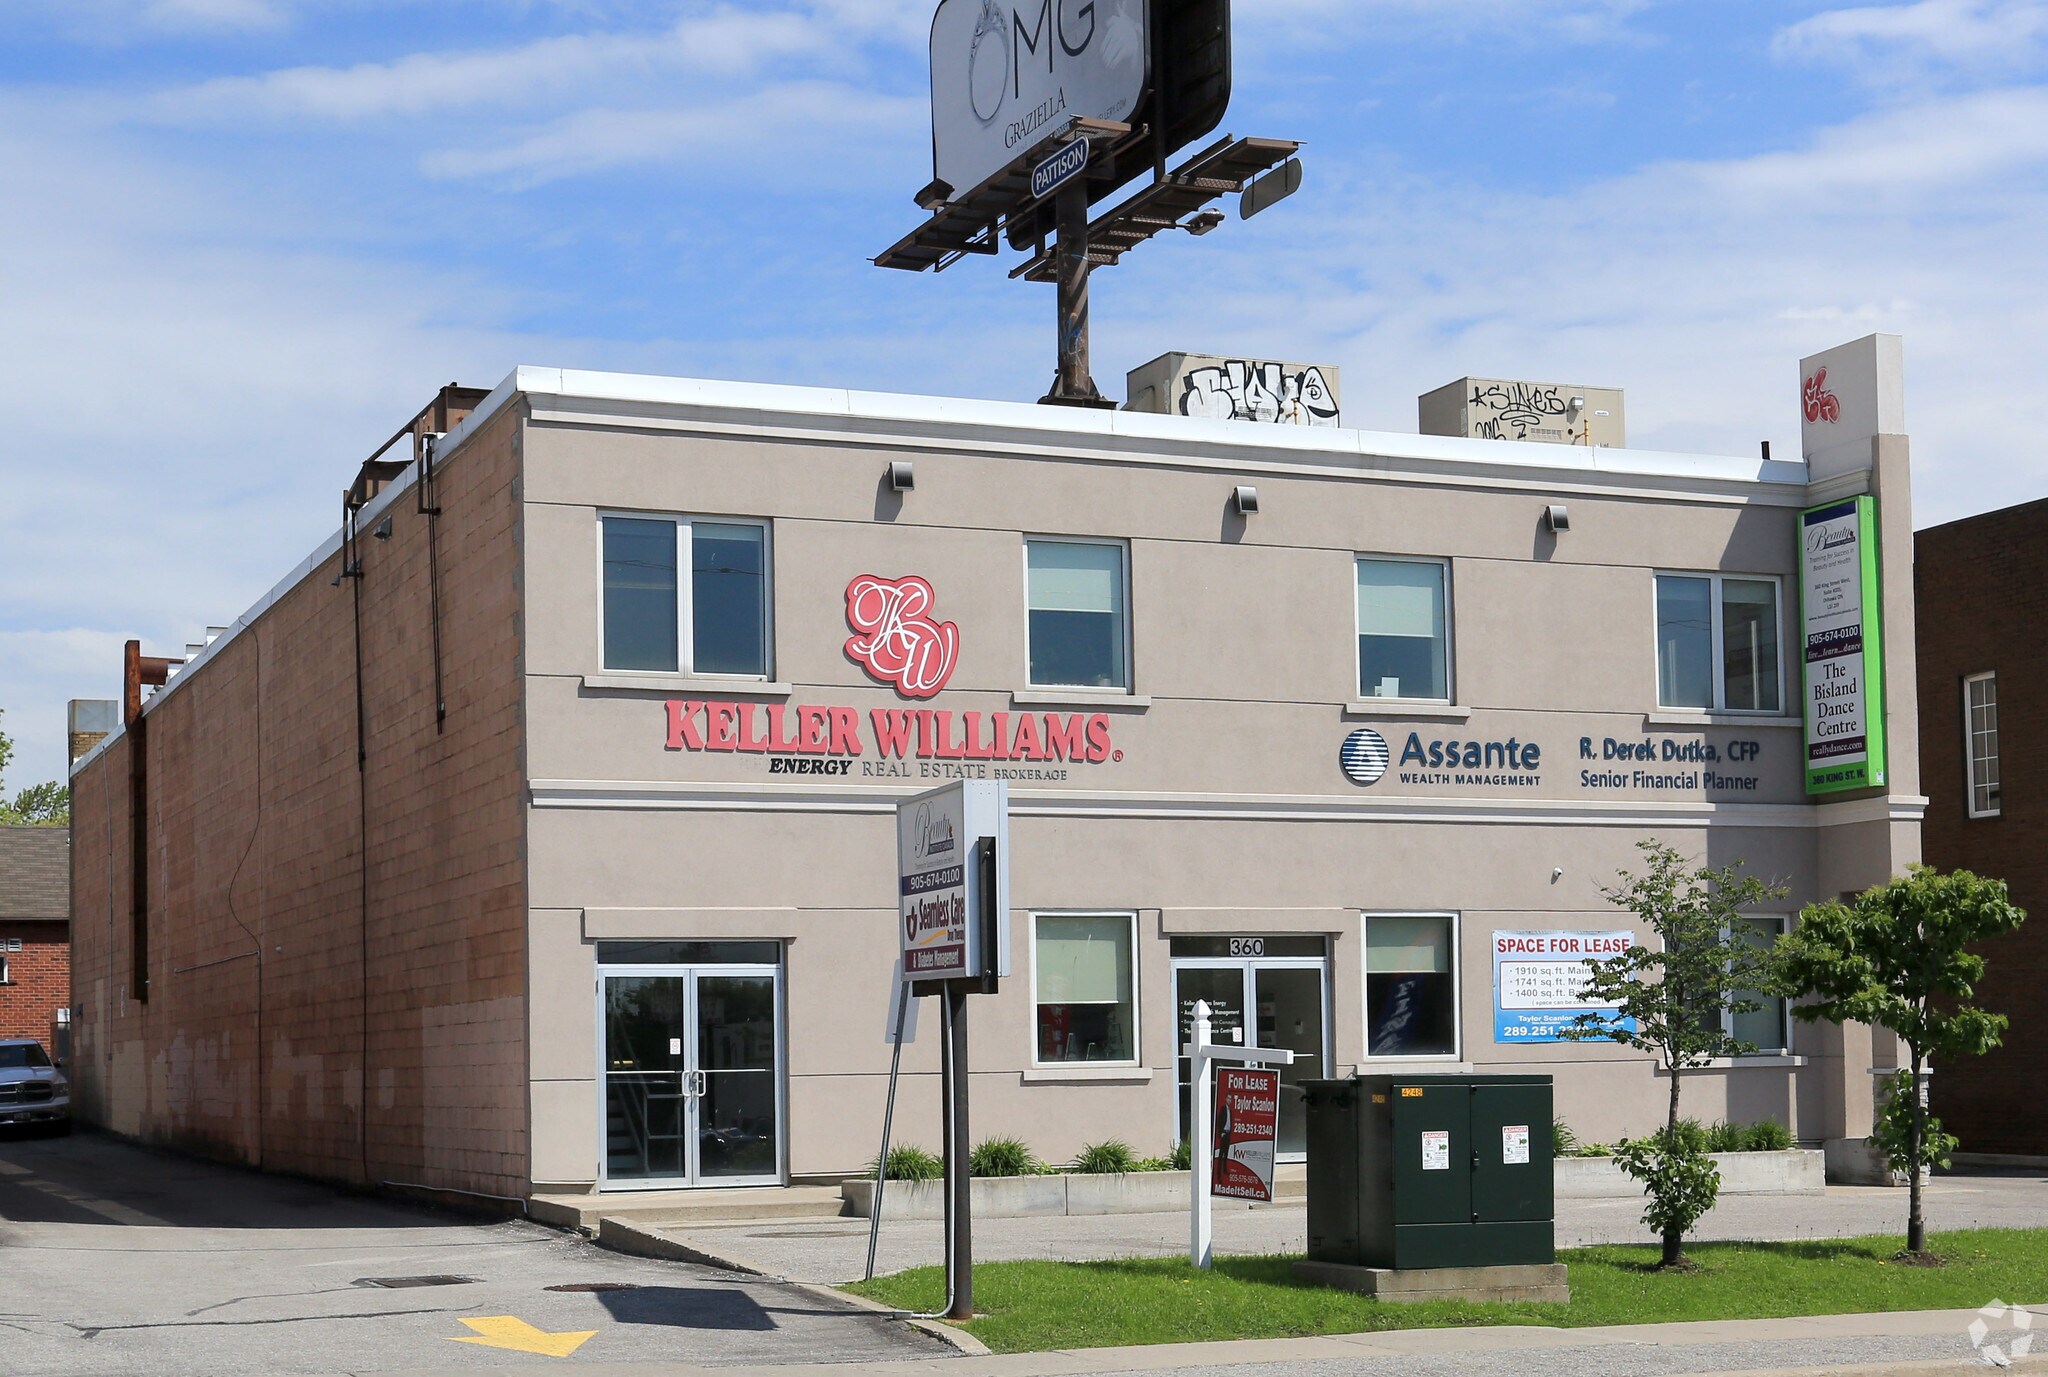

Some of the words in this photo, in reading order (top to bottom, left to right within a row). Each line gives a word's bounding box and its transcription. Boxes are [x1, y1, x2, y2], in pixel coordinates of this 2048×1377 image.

[1004, 87, 1066, 149] GRAZIELLA
[1036, 144, 1084, 191] PATTISON
[1807, 525, 1851, 553] Beauty
[1810, 626, 1859, 645] 905-674-0100
[1823, 662, 1846, 680] The
[1814, 678, 1857, 700] Bisland
[1818, 702, 1855, 718] Dance
[664, 700, 863, 757] KELLER
[869, 709, 1112, 764] WILLIAMS
[1817, 720, 1857, 737] Centre
[1399, 732, 1541, 770] Assante
[1603, 737, 1657, 762] Derek
[1662, 739, 1722, 764] Dutka,
[1727, 740, 1761, 762] CFP
[1813, 741, 1863, 756] reallydance.com
[769, 758, 853, 775] ENERGY
[862, 761, 912, 778] REAL
[919, 762, 986, 779] ESTATE
[994, 768, 1067, 780] BROKERAGE
[1826, 771, 1843, 783] KING
[1399, 773, 1450, 784] WEALTH
[1455, 774, 1541, 786] MANAGEMENT
[1581, 769, 1629, 788] Senior
[1633, 770, 1698, 789] Financial
[1703, 771, 1758, 790] Planner
[911, 868, 960, 890] 905-674-0100
[919, 894, 949, 930] Seamless
[951, 892, 965, 925] Care
[1231, 939, 1264, 955] 360
[1497, 938, 1545, 953] SPACE
[1550, 938, 1579, 953] FOR
[1584, 938, 1630, 953] LEASE
[1515, 967, 1537, 975] 1910
[1568, 966, 1591, 975] Main
[1515, 978, 1537, 986] 1741
[1516, 989, 1538, 997] 1400
[1234, 1095, 1251, 1113] Taylor
[1252, 1096, 1274, 1112] Scanlon
[1234, 1123, 1273, 1135] 289-251-2340
[1214, 1184, 1265, 1198] MadeItSell.ca
